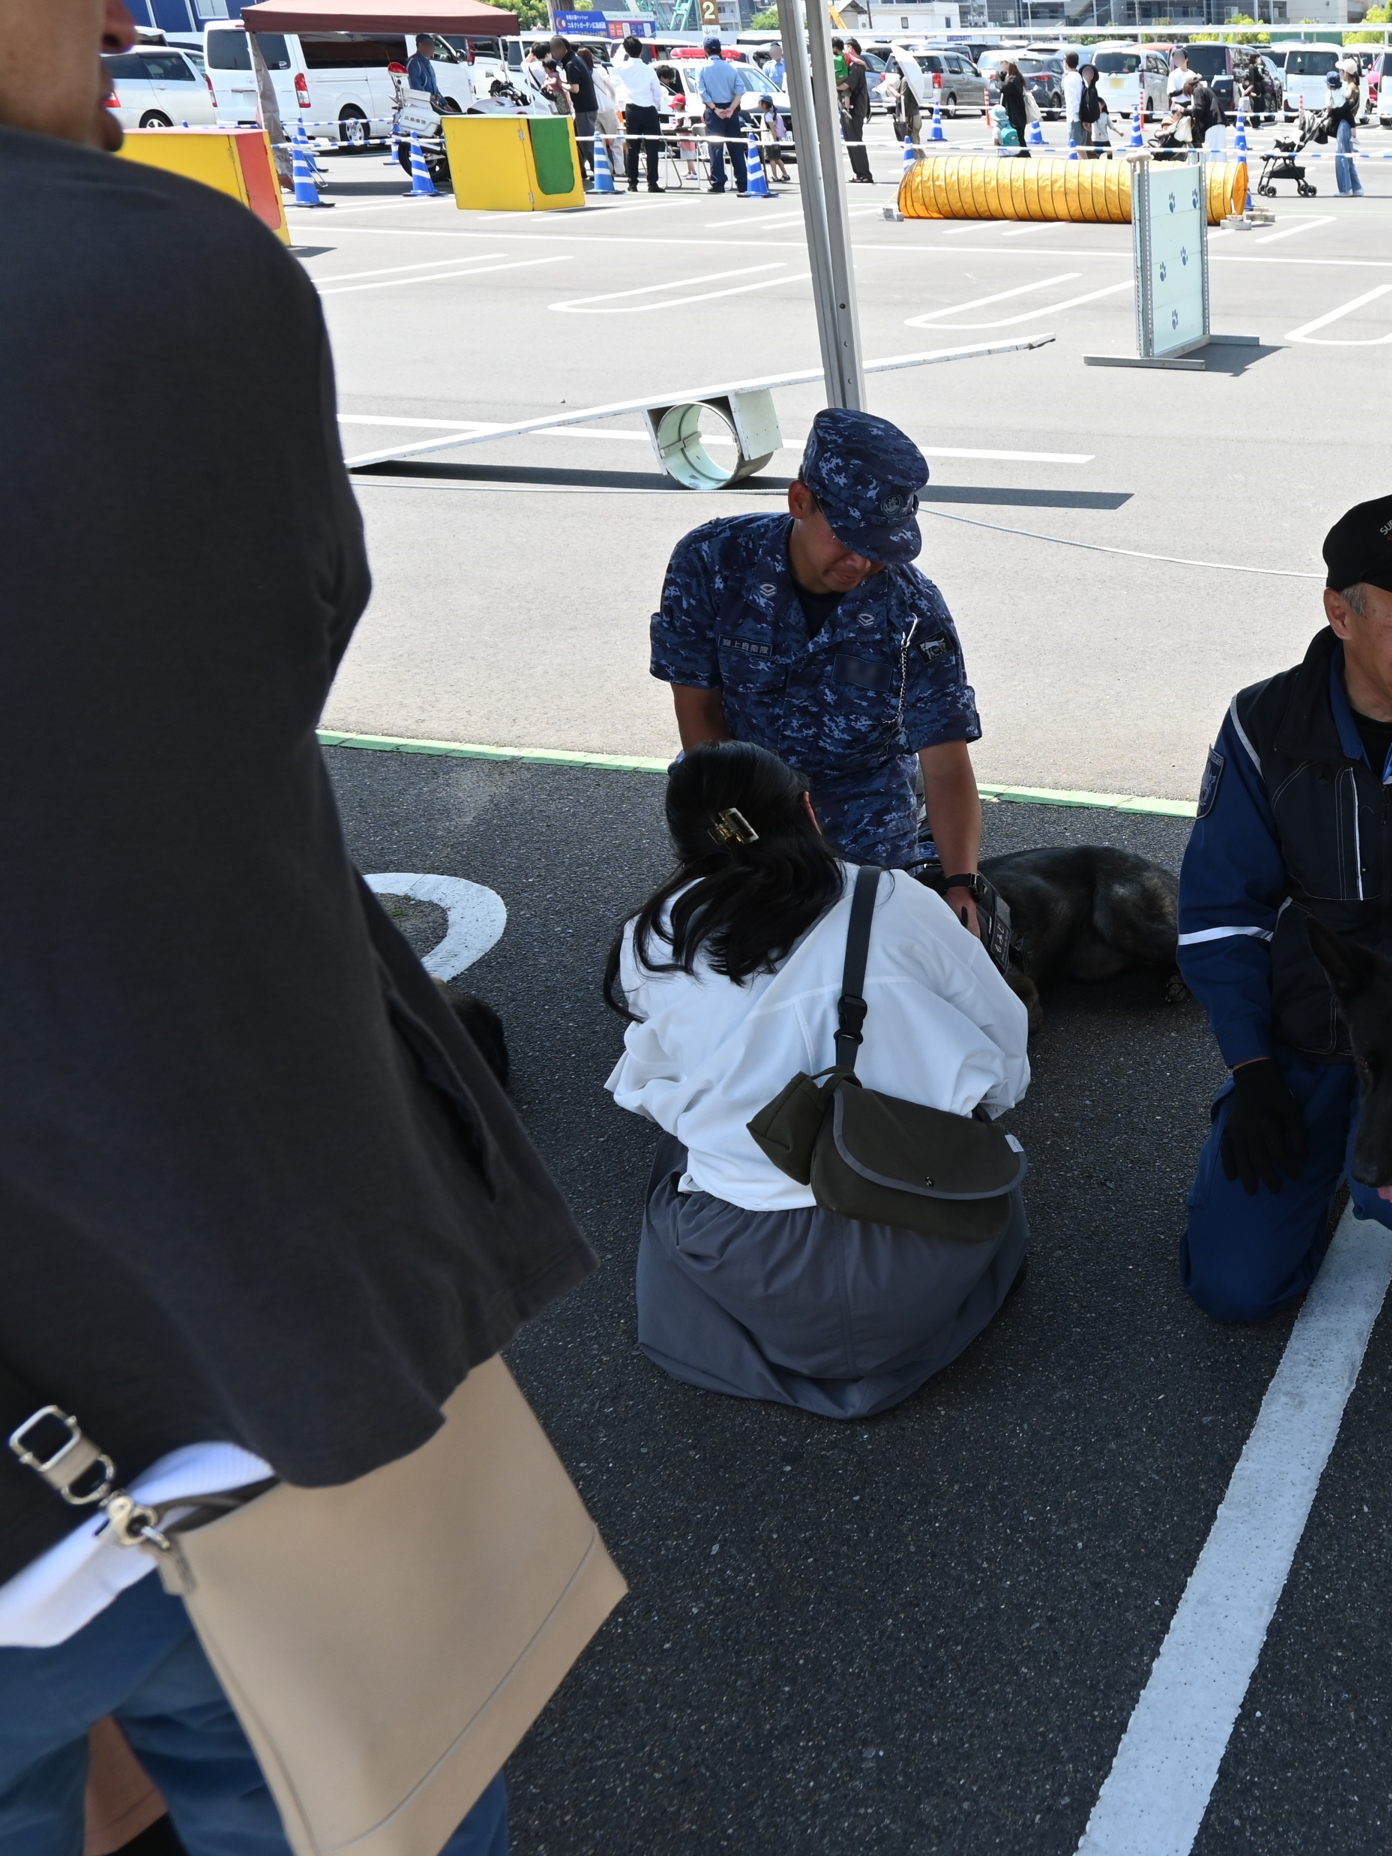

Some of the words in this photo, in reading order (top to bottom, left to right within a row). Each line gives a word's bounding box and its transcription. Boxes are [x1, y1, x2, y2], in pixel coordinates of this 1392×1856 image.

[702, 1, 716, 19] 2
[721, 638, 769, 655] 海上自衛隊
